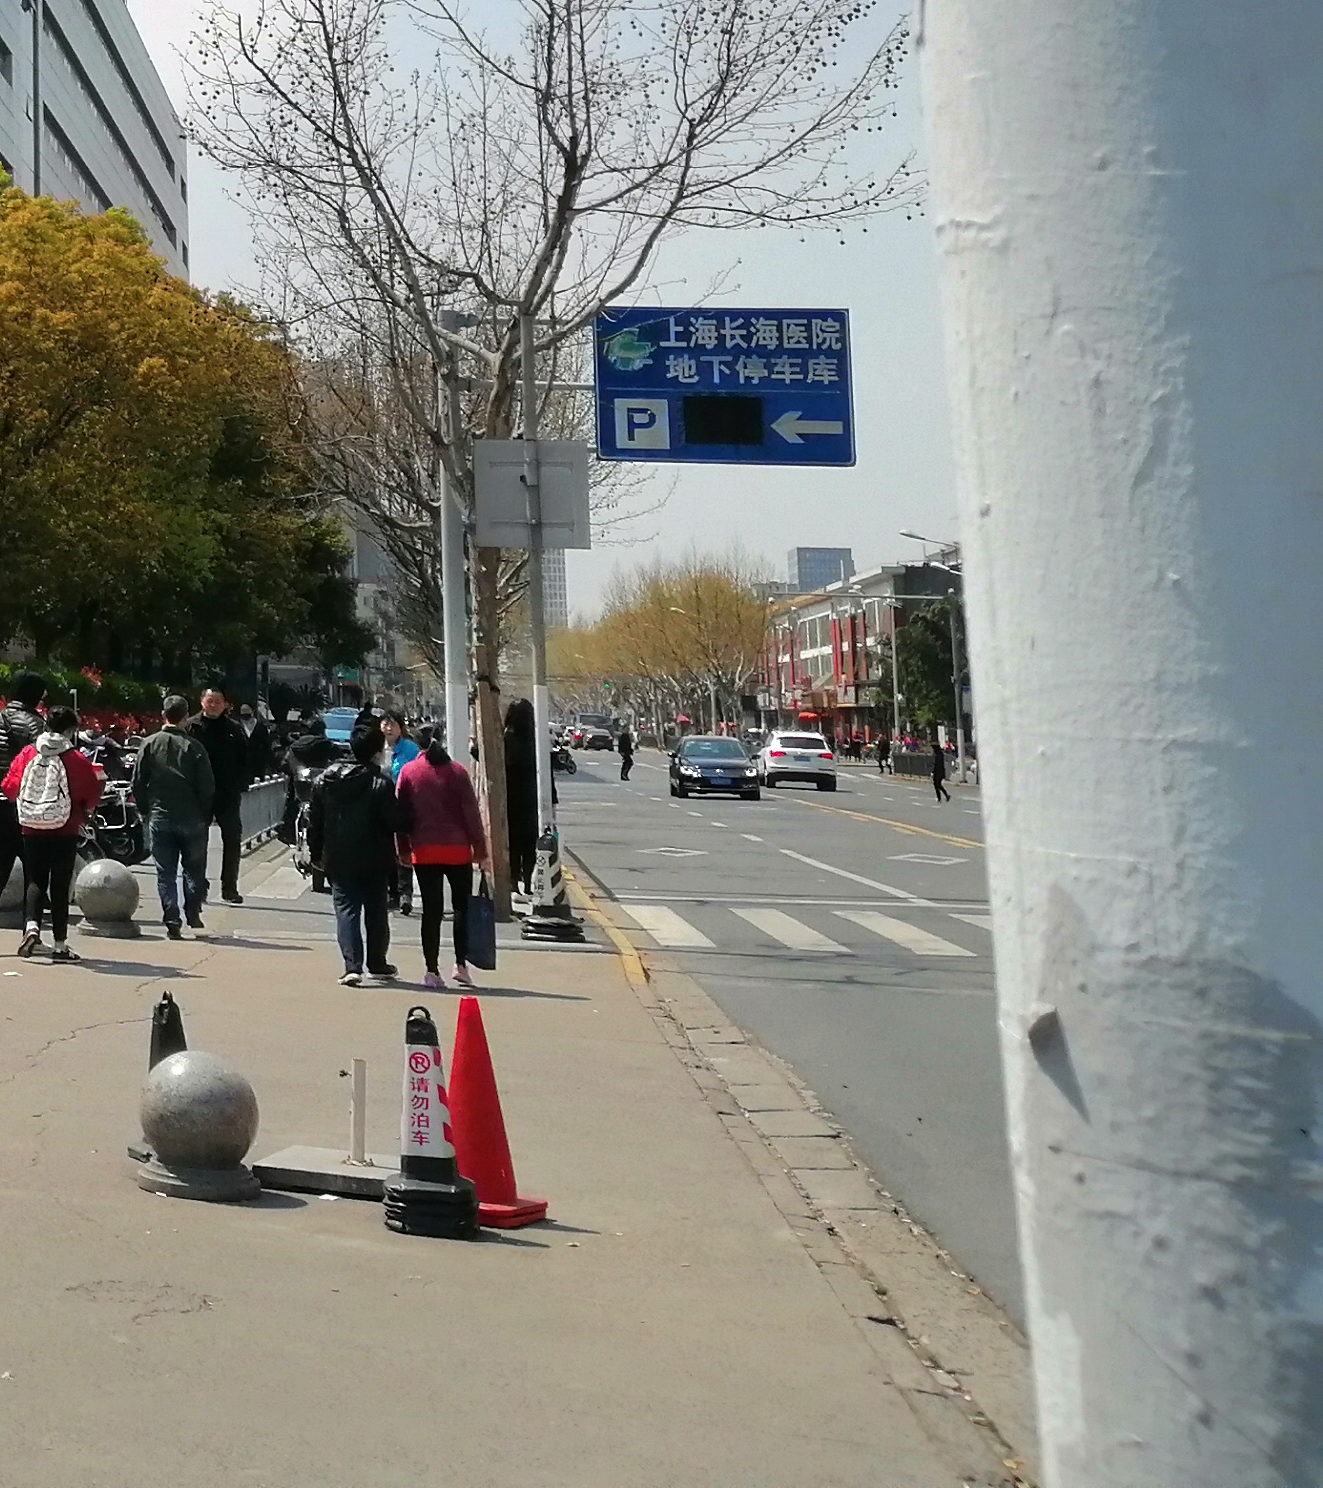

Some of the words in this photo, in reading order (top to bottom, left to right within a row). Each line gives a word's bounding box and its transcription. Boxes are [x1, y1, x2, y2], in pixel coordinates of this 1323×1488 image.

[659, 316, 842, 351] 上海长海医院
[665, 354, 840, 384] 地下停车库
[627, 407, 656, 441] P
[411, 1077, 431, 1146] 请勿泊车
